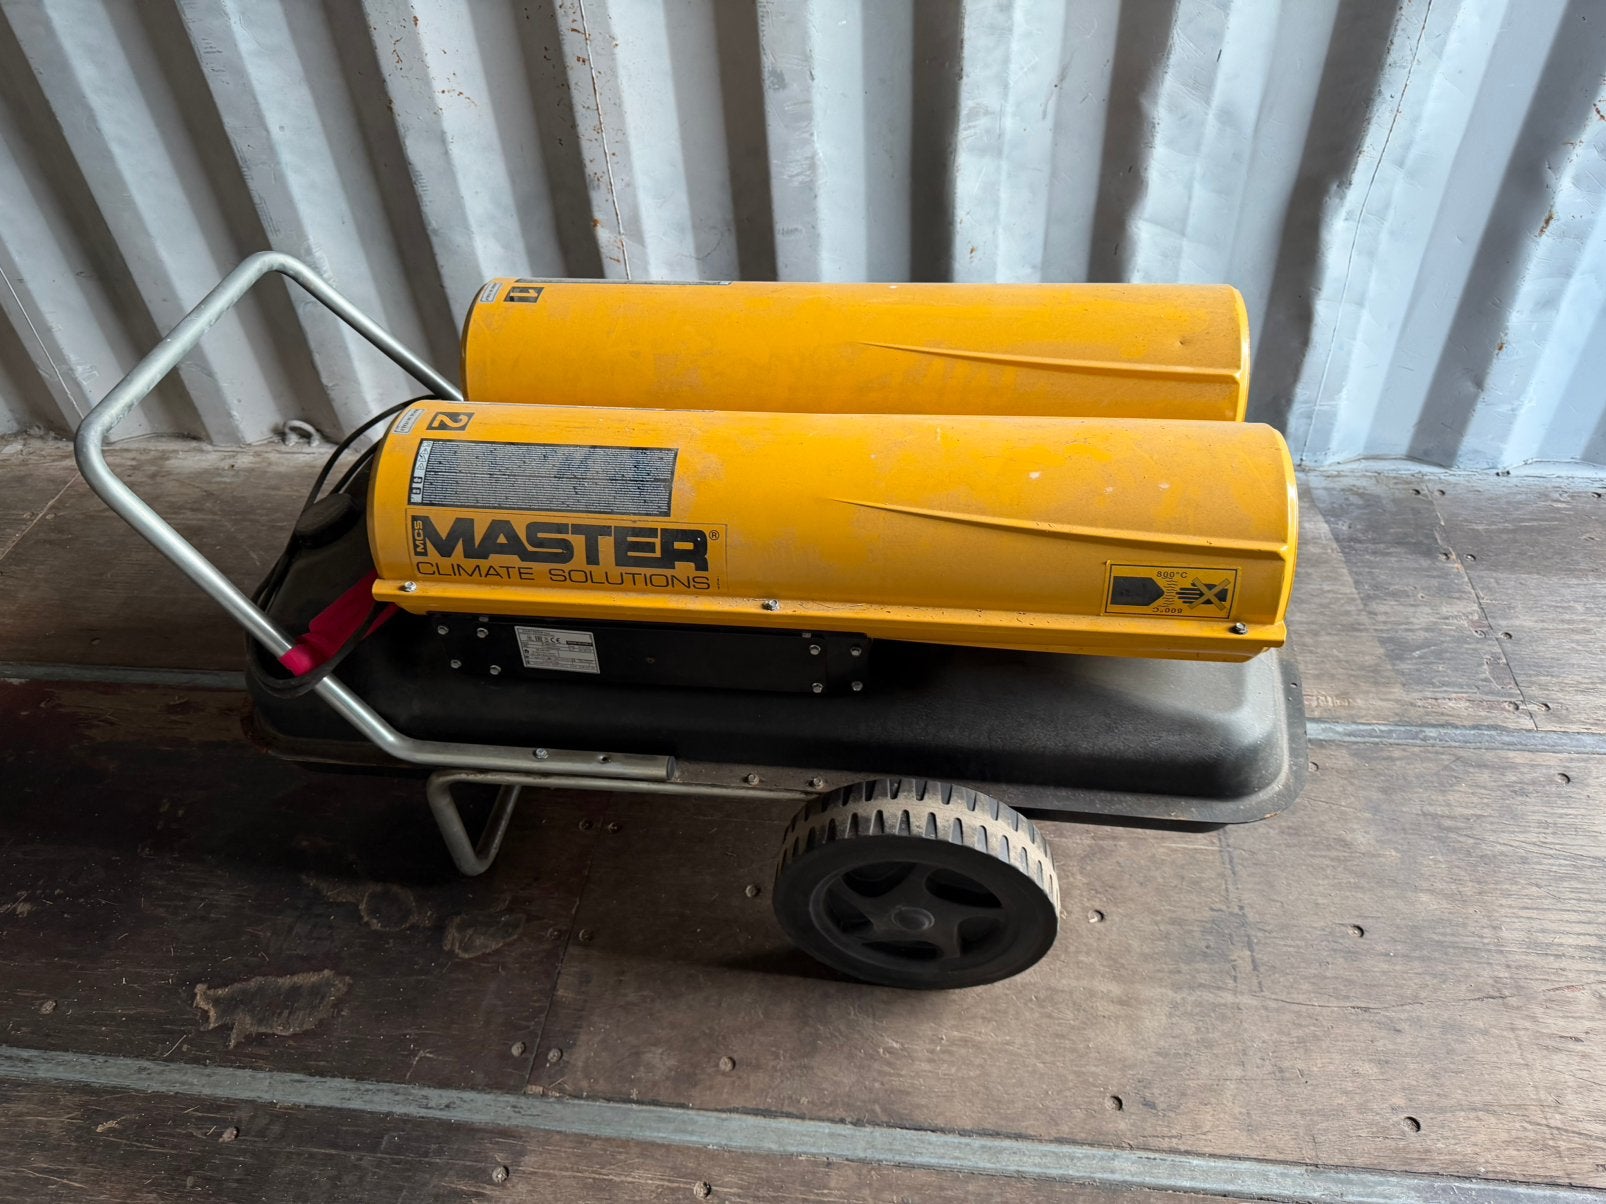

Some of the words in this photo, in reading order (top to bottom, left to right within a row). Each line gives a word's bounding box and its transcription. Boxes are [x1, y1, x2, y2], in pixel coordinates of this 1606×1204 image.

[432, 414, 468, 428] 2
[414, 520, 425, 553] MCS
[416, 561, 536, 581] CLIMATE
[549, 568, 711, 590] SOLUTIONS
[1156, 570, 1188, 579] 800°C
